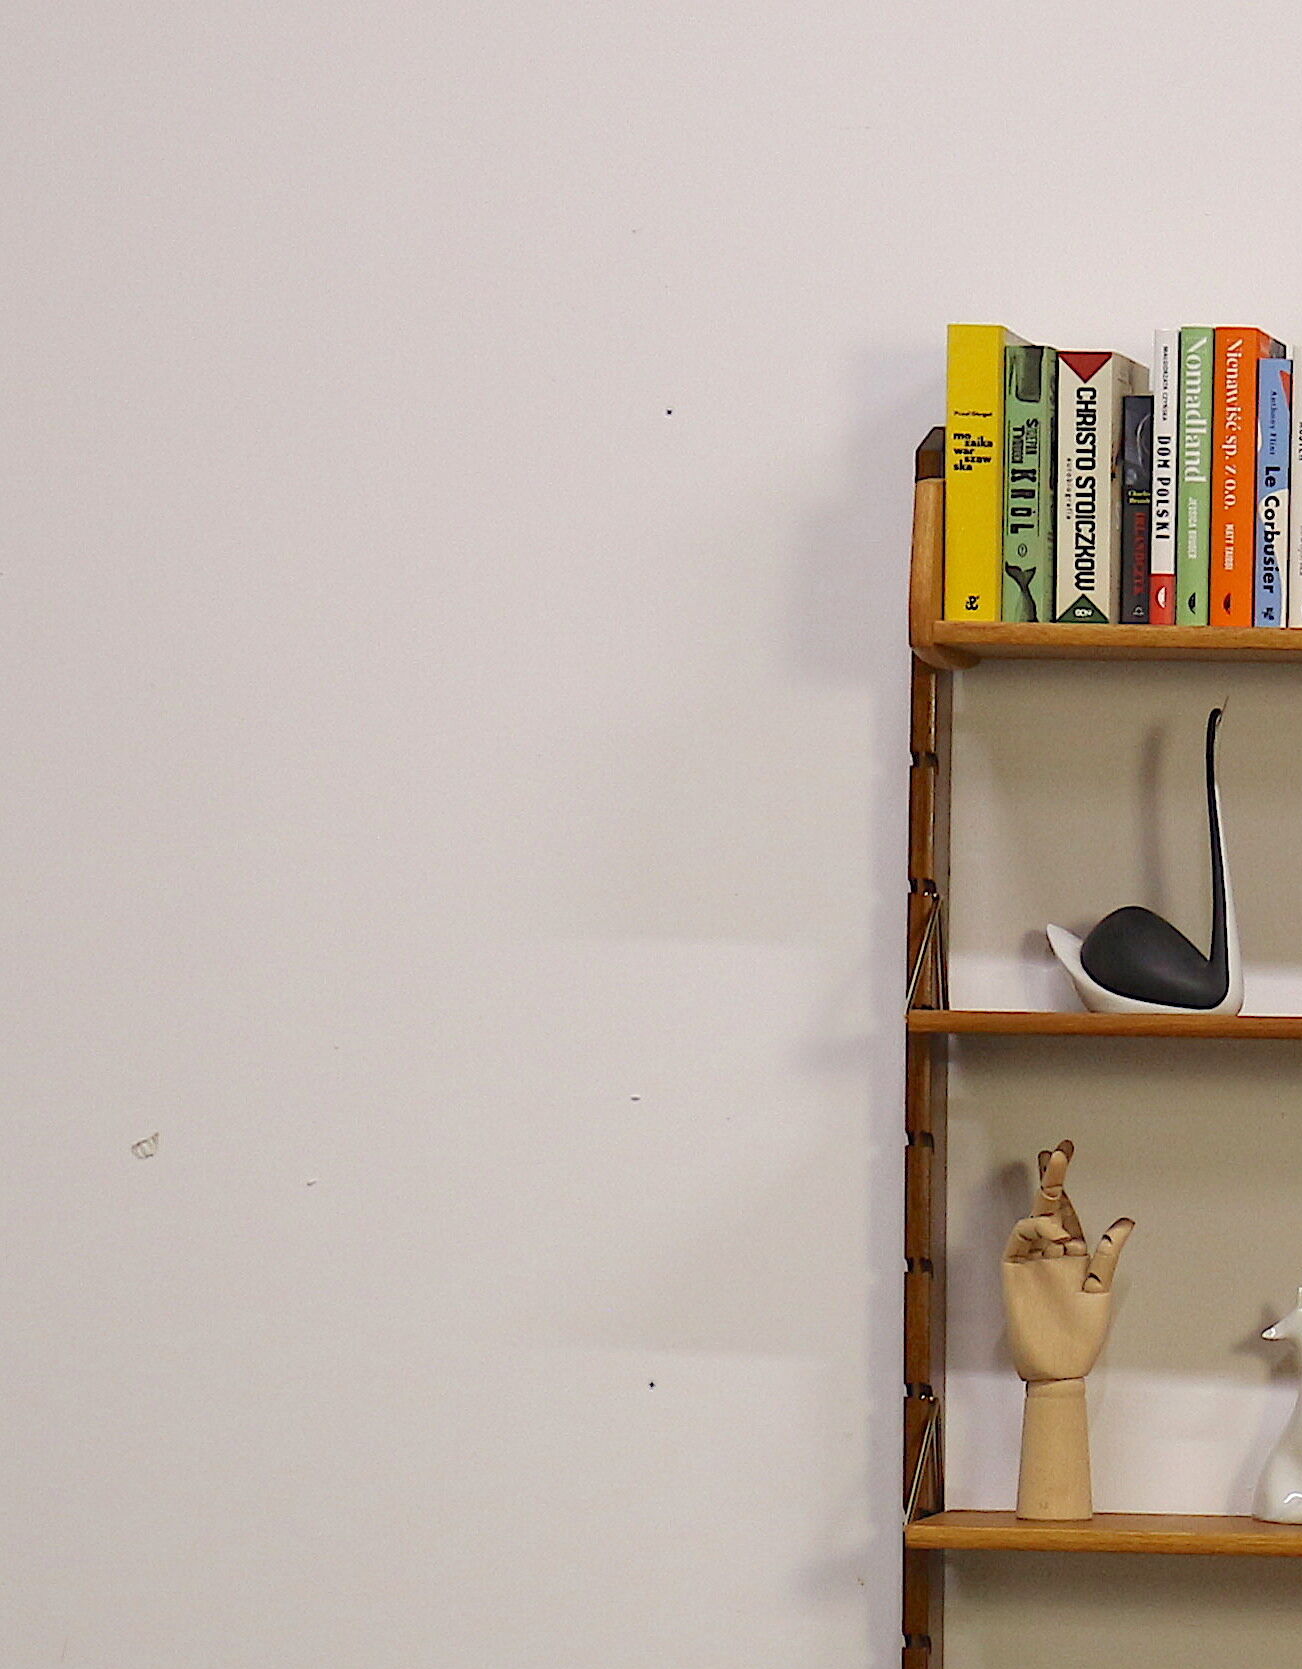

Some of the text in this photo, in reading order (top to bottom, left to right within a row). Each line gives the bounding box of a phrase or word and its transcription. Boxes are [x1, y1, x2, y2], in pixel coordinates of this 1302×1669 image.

[1185, 337, 1208, 483] Nomadland
[1225, 339, 1243, 431] Nienawiść
[1075, 387, 1096, 591] CHRISTO STOICZKOW
[1156, 436, 1171, 539] DOM POLSKI
[1221, 435, 1238, 460] sp.
[1224, 479, 1238, 510] o.o.
[1011, 468, 1036, 534] KRÓL
[1263, 466, 1280, 594] Le Corbusier
